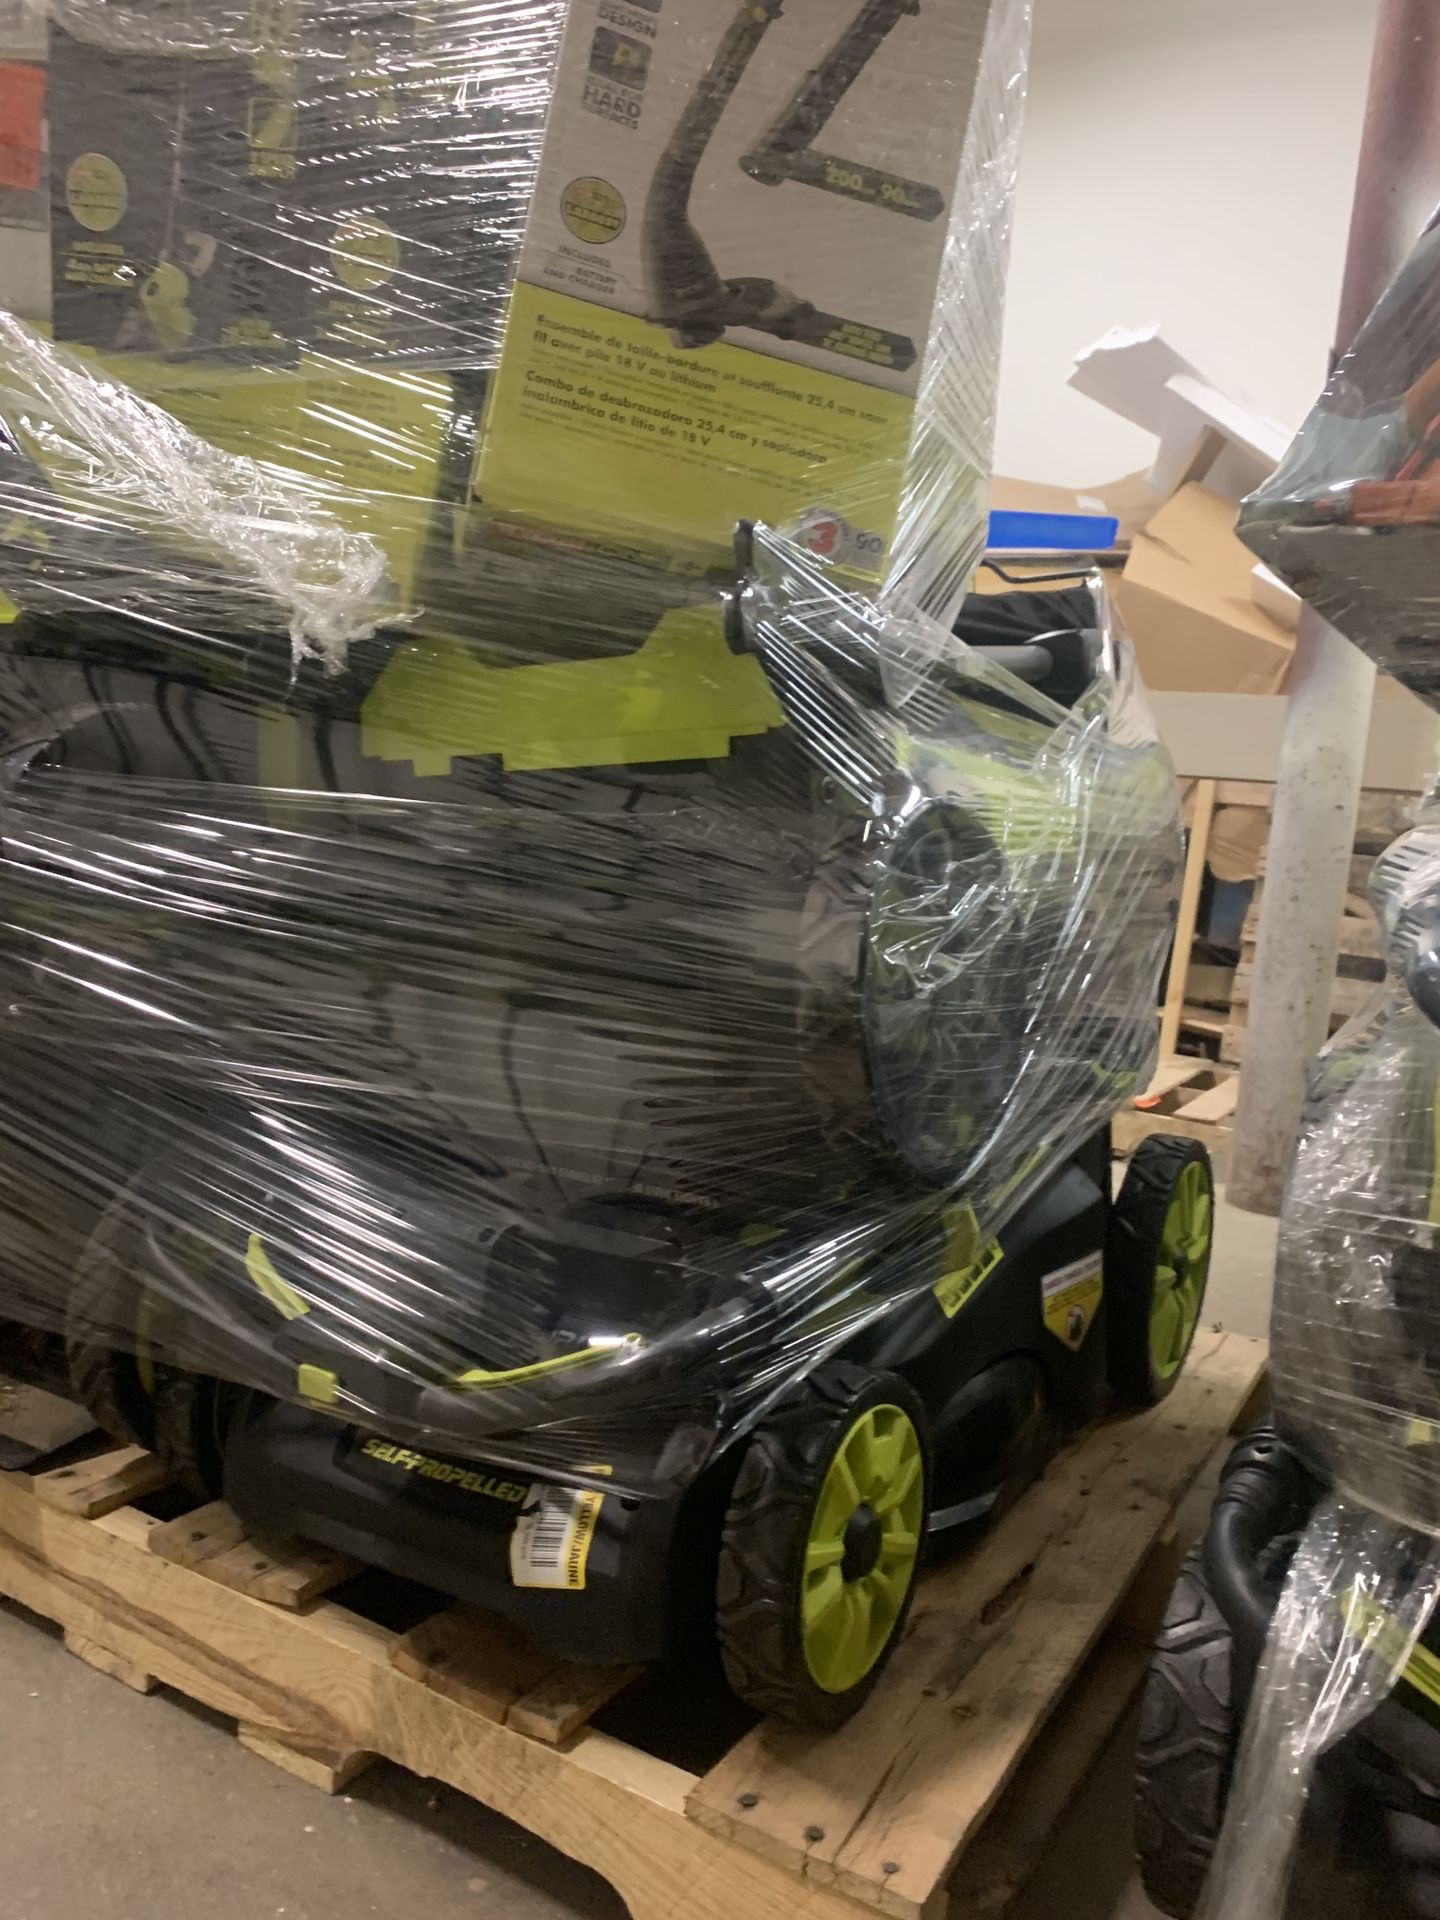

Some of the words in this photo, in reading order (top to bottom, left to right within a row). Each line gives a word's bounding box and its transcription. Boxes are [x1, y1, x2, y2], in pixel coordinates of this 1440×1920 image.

[605, 336, 623, 349] de
[616, 354, 632, 368] 18
[636, 360, 647, 371] V
[526, 369, 574, 393] Combo
[578, 385, 596, 398] de
[610, 410, 626, 424] de
[660, 424, 677, 437] de
[682, 430, 697, 444] 18
[702, 436, 712, 447] V
